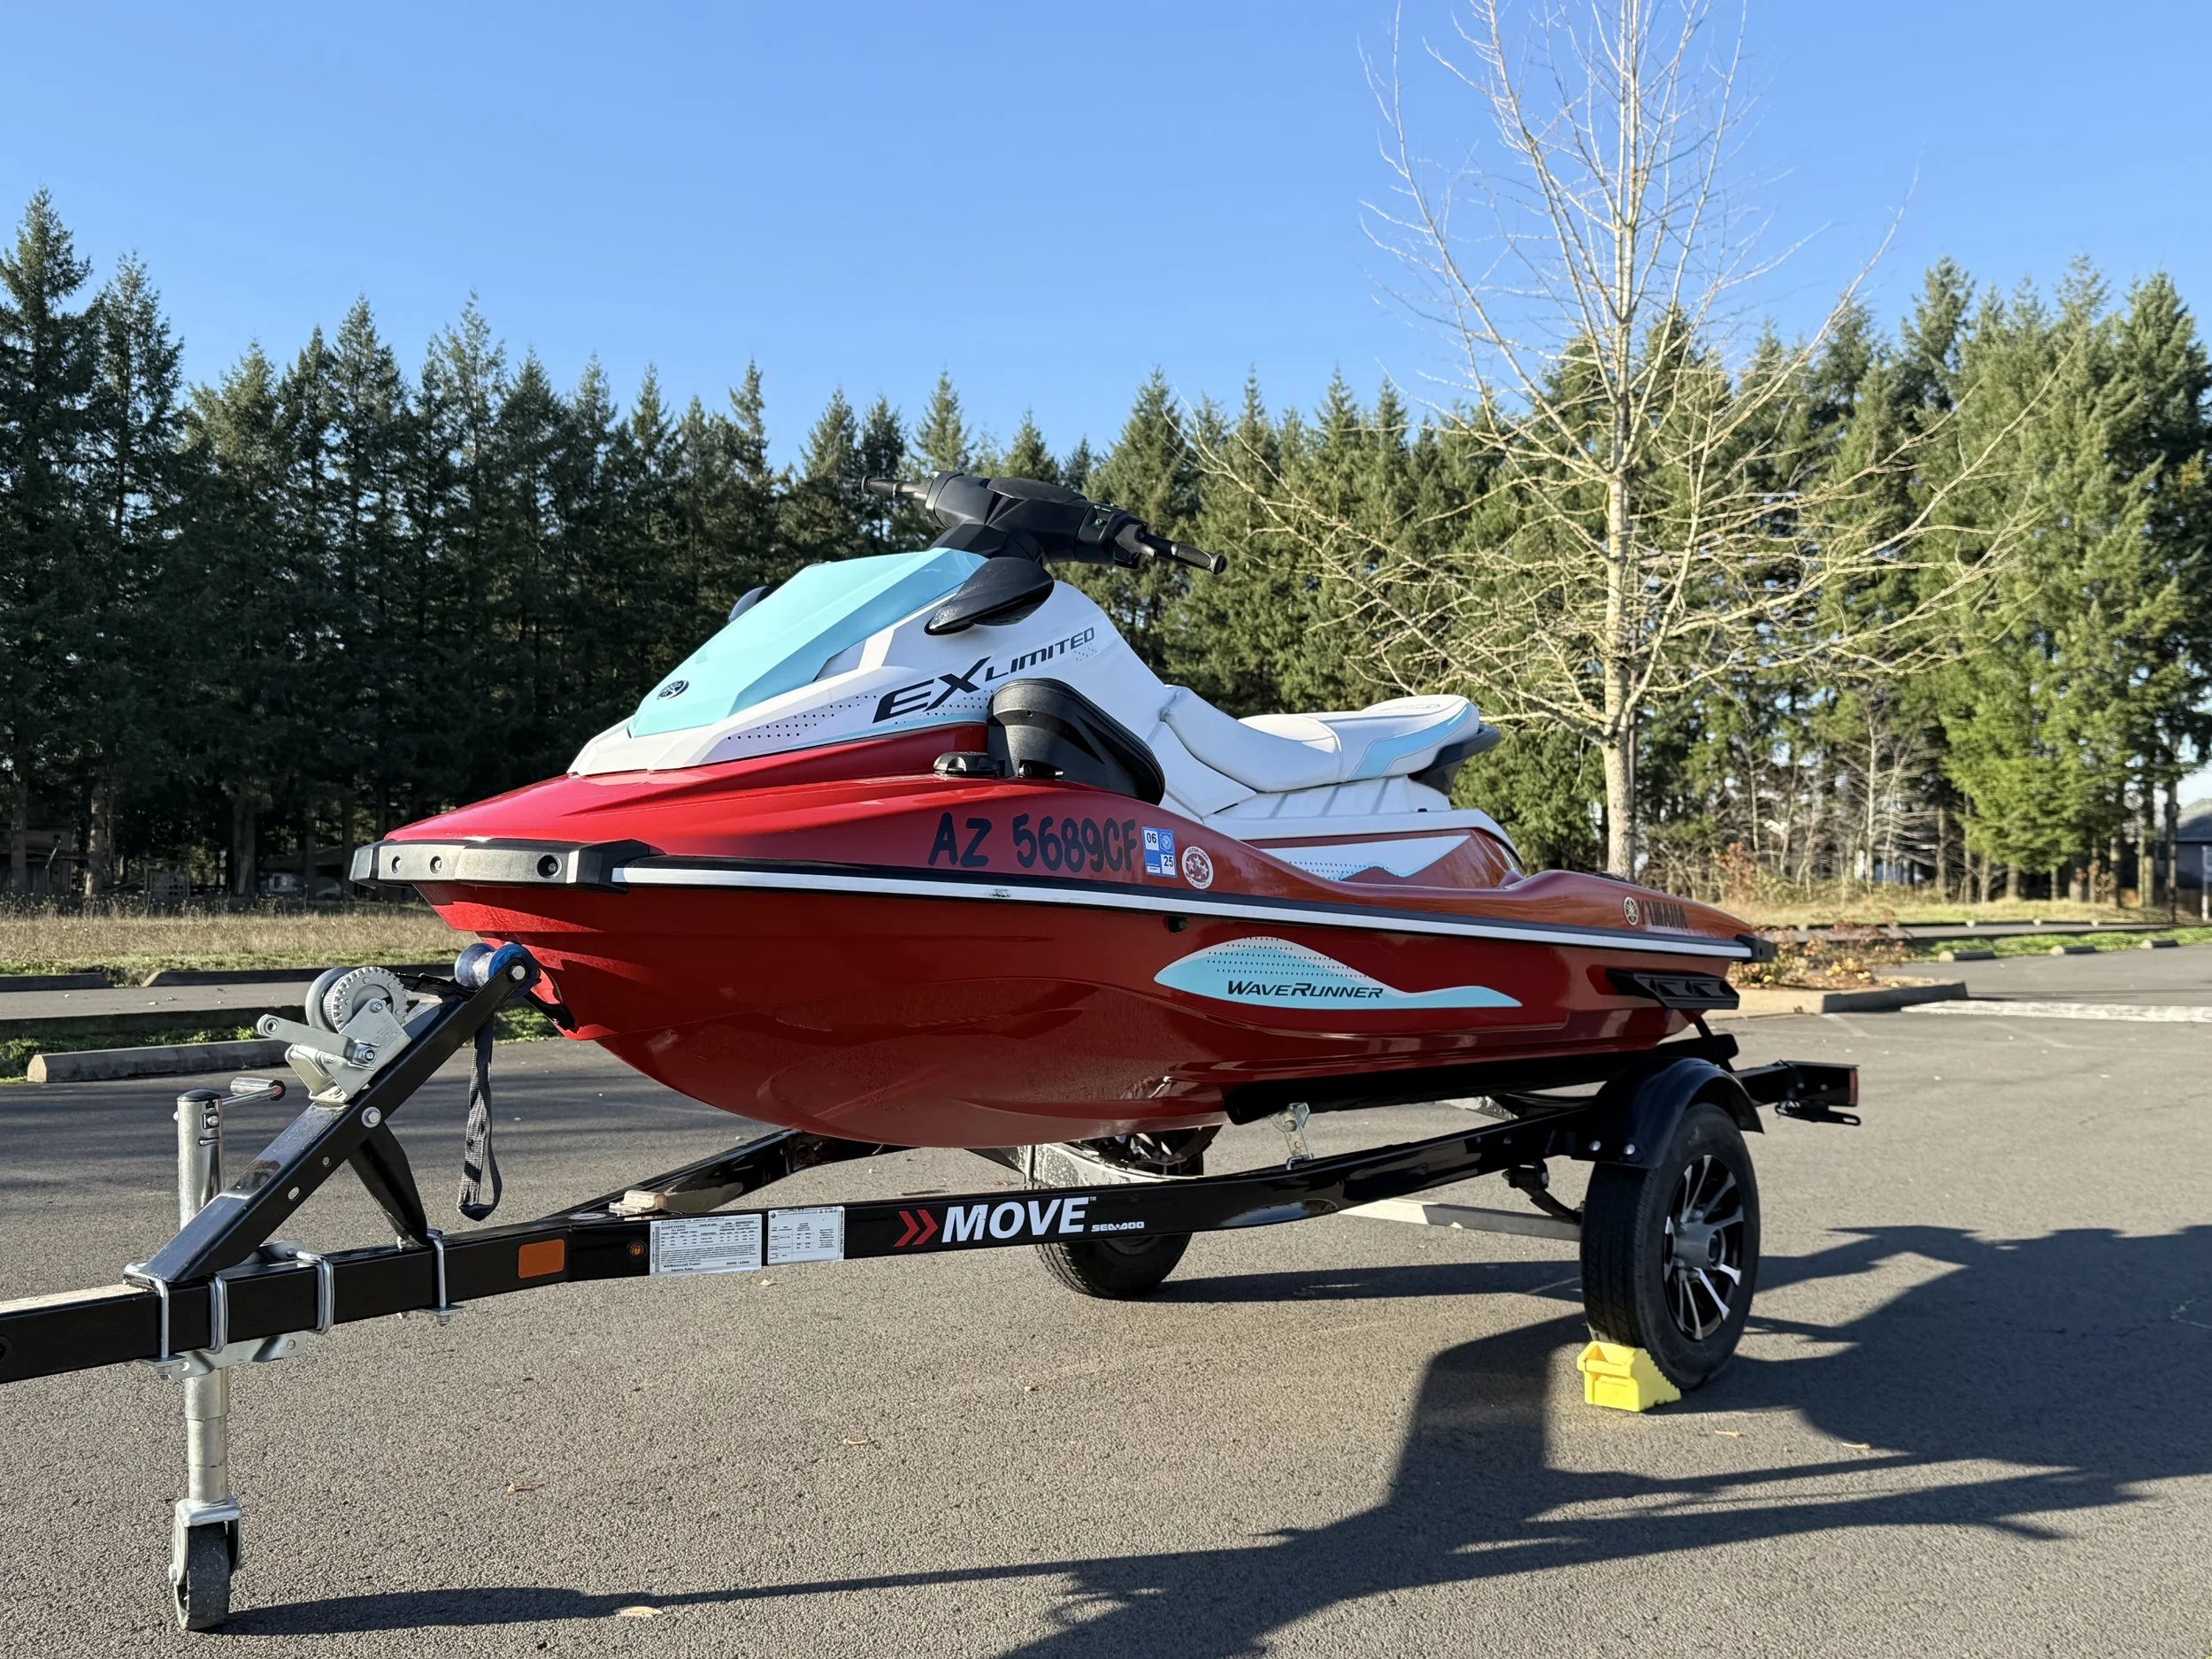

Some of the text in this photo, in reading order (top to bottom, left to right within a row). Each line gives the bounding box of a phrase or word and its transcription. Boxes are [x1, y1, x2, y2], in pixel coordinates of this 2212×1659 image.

[872, 626, 1095, 724] EX LIMITED
[927, 811, 1138, 872] AZ 5689CF
[1146, 832, 1157, 843] 06
[1164, 856, 1174, 867] 25
[1227, 980, 1384, 999] WAVERUNNER
[941, 1197, 1089, 1243] MOVE
